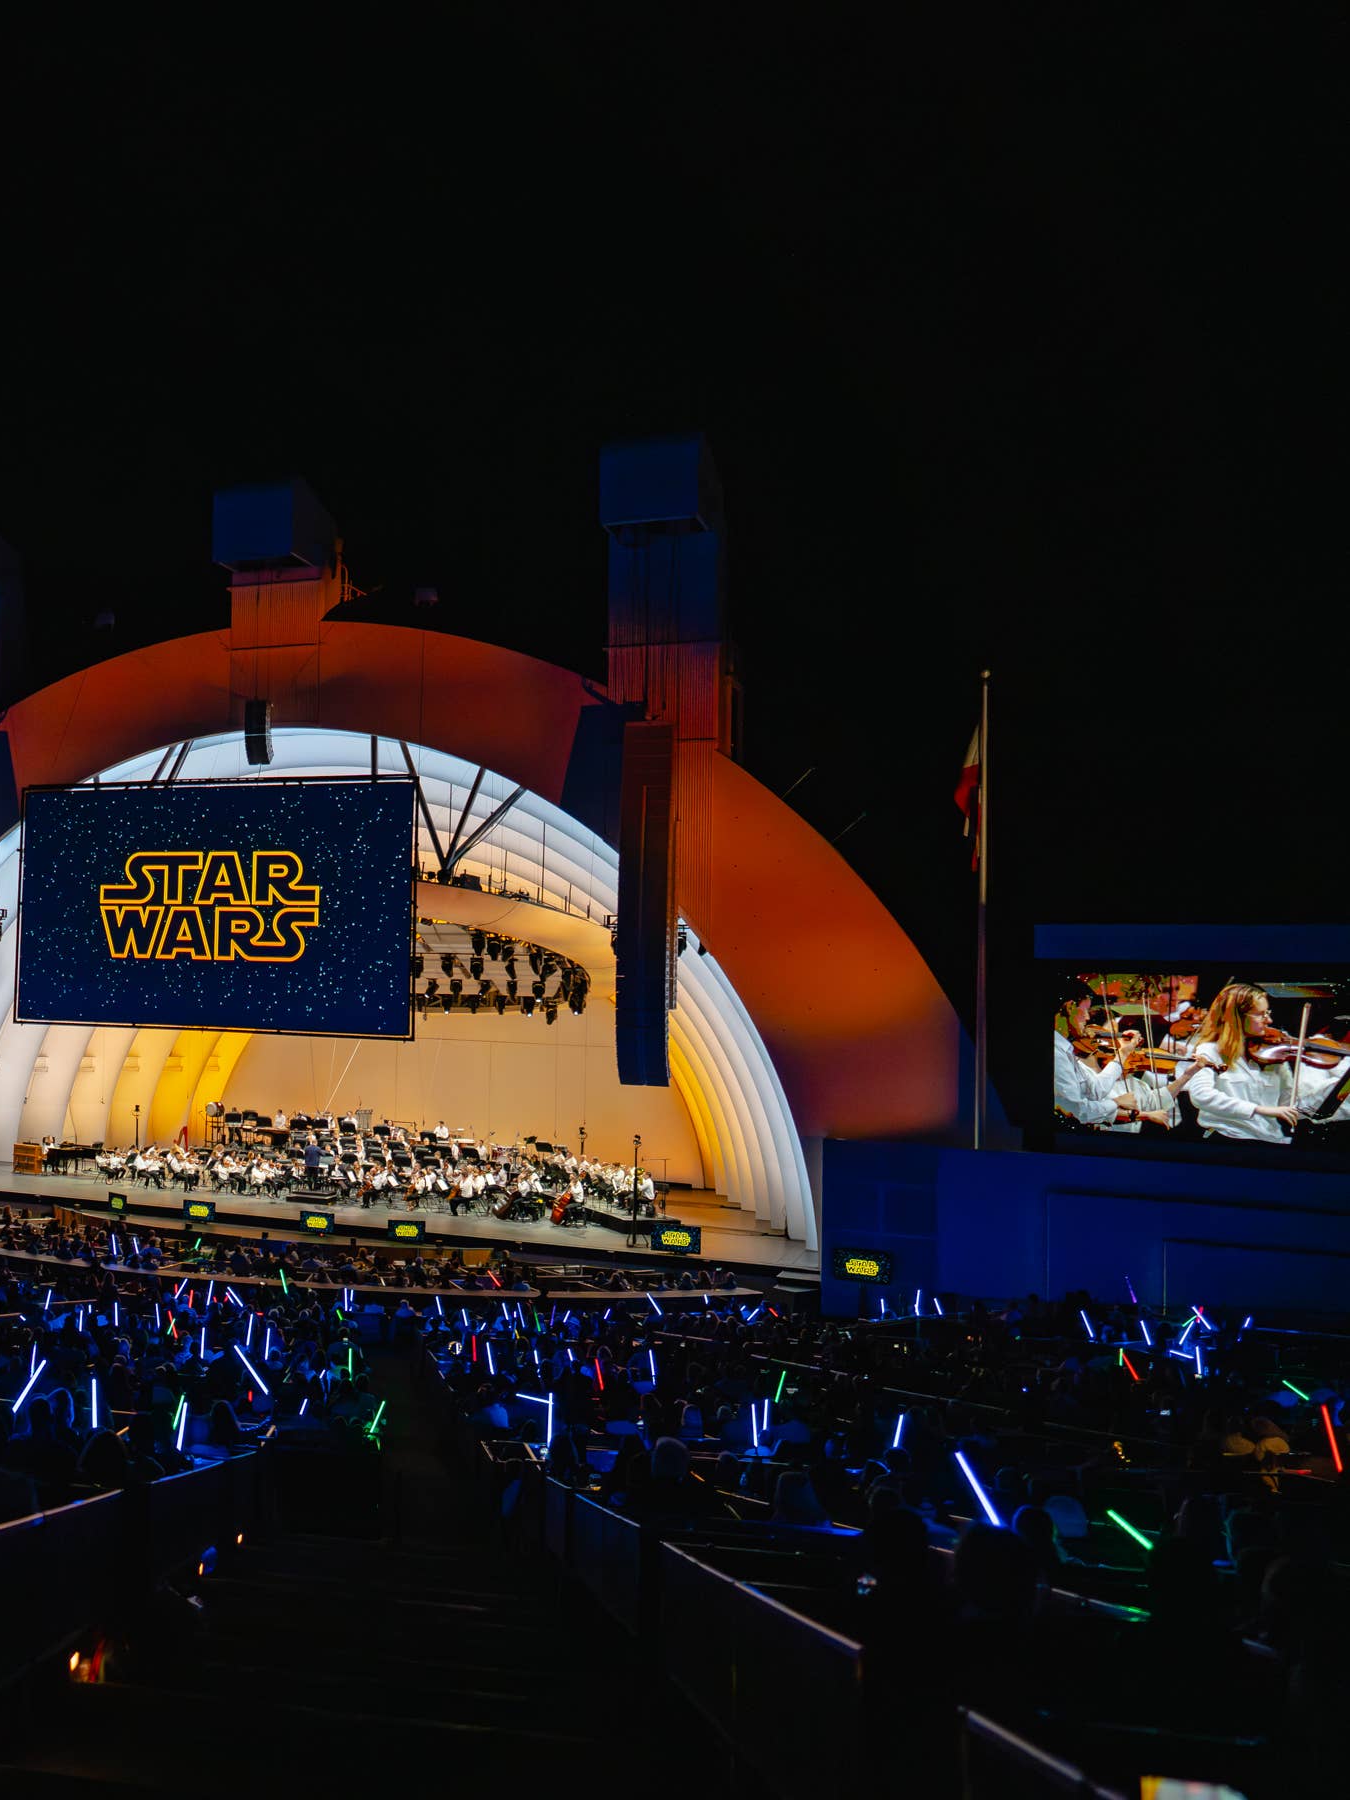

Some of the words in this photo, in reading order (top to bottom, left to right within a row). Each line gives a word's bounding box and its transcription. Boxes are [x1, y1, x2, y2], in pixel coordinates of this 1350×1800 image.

[99, 850, 320, 906] STAR
[100, 905, 320, 962] WARS
[846, 1258, 879, 1268] STAR
[846, 1265, 879, 1276] WARS
